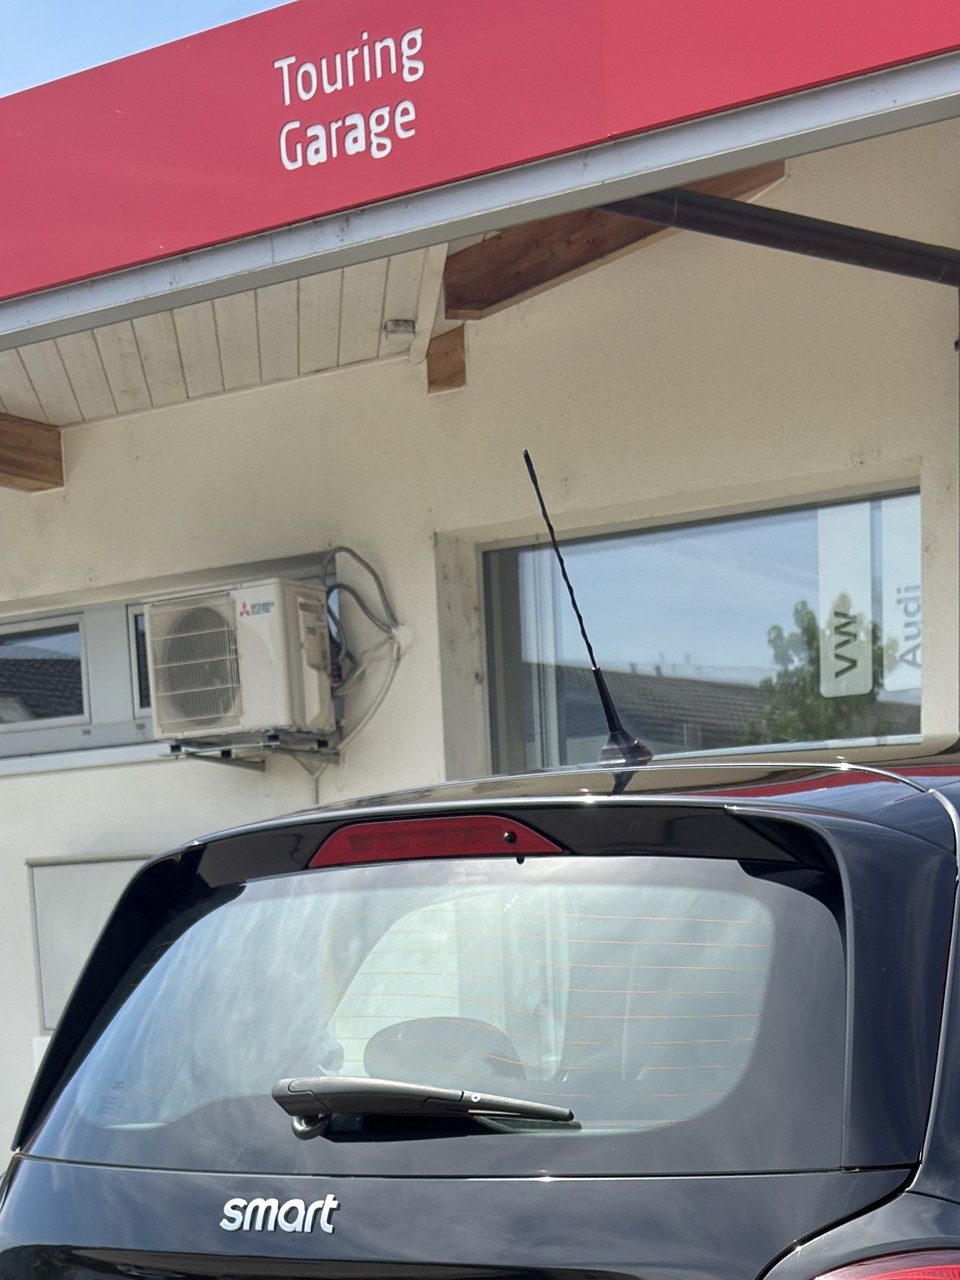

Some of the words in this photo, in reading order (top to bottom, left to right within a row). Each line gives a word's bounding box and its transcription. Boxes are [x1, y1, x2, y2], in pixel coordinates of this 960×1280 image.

[273, 27, 425, 107] Touring
[279, 99, 417, 171] Garage
[834, 611, 858, 680] VW
[897, 584, 922, 669] Audi
[219, 1193, 340, 1234] smart
